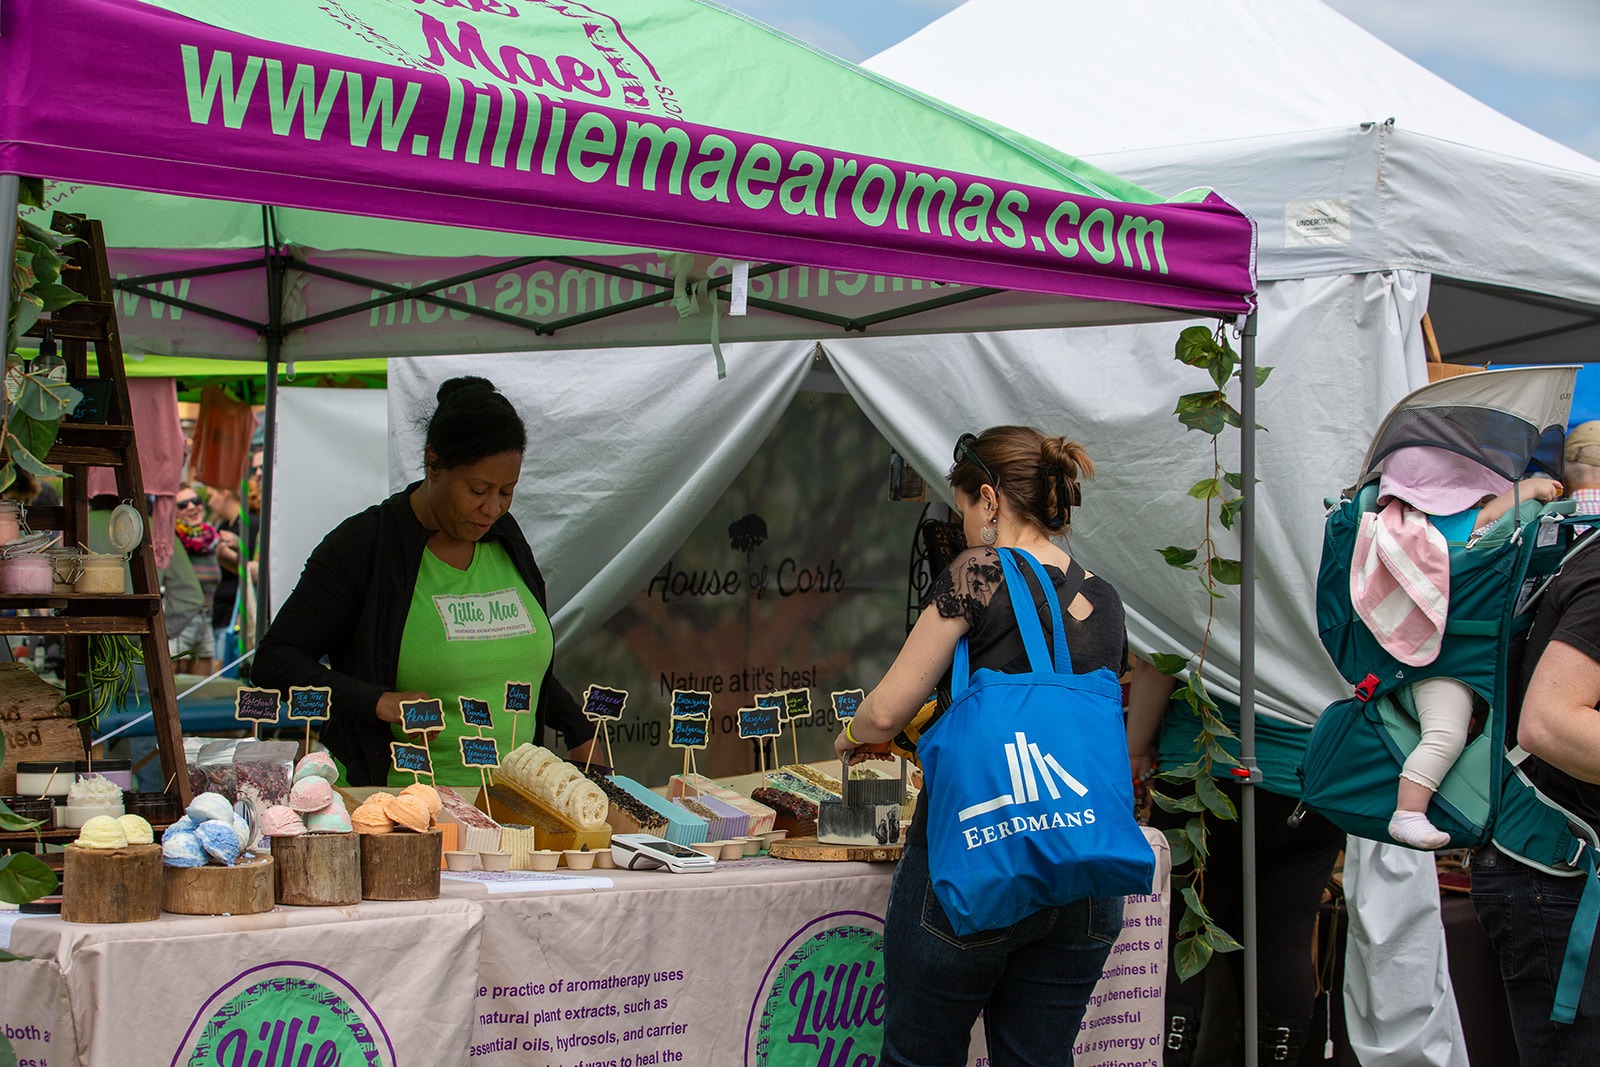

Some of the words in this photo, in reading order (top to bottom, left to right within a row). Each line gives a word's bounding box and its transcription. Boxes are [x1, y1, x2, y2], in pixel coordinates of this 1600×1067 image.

[415, 9, 611, 98] Mae
[181, 44, 1169, 274] www.lilliemaearomas.com
[648, 561, 741, 602] House
[750, 565, 769, 600] of
[777, 558, 845, 597] Cork
[448, 601, 484, 627] Lillie
[487, 600, 519, 624] Mae
[660, 671, 723, 697] Nature
[730, 668, 749, 692] at
[752, 667, 774, 691] it's
[780, 665, 817, 688] best
[962, 808, 1096, 850] EERDMANS
[1123, 917, 1141, 929] kes
[1145, 915, 1162, 927] the
[1113, 940, 1150, 955] aspects
[492, 982, 545, 1000] practice
[549, 979, 564, 994] of
[566, 973, 651, 993] aromatherapy
[653, 970, 684, 983] uses
[1101, 964, 1147, 980] combines
[1150, 962, 1159, 975] it
[787, 960, 885, 1052] Lillie
[1108, 986, 1162, 1001] beneficial
[479, 1010, 529, 1026] natural
[533, 1008, 561, 1027] plant
[564, 1004, 620, 1020] extracts,
[623, 998, 651, 1014] such
[653, 998, 668, 1010] as
[1089, 1011, 1141, 1029] successful
[6, 1023, 41, 1041] both
[469, 1037, 518, 1057] essential
[522, 1037, 553, 1053] oils,
[556, 1030, 620, 1053] hydrosols,
[623, 1026, 644, 1042] and
[646, 1022, 688, 1038] carrier
[1072, 1043, 1083, 1056] nd
[1098, 1037, 1146, 1052] synergy
[1149, 1034, 1161, 1046] of
[620, 1055, 632, 1067] to
[635, 1051, 659, 1067] heal
[662, 1049, 683, 1063] the
